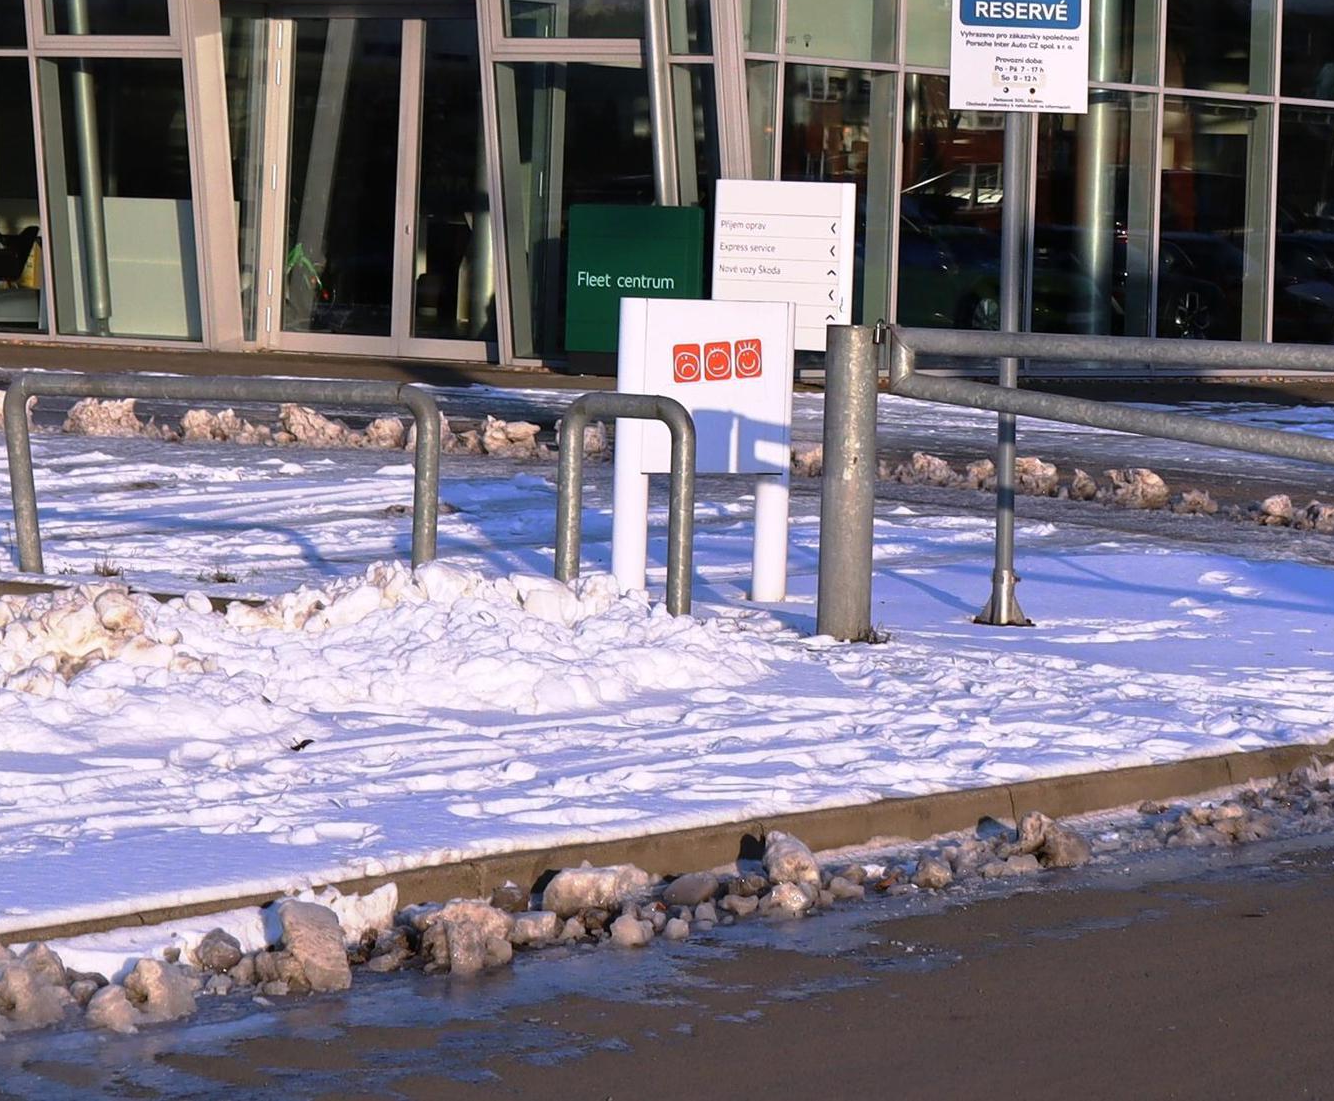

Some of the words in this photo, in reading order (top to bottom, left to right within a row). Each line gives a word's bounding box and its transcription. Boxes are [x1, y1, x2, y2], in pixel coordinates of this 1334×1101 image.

[975, 0, 1068, 21] RESERVÉ
[719, 242, 748, 252] Express
[719, 264, 738, 273] Nové
[739, 266, 757, 275] vozy
[758, 264, 781, 275] Škoda
[577, 271, 611, 287] Fleet
[617, 274, 675, 289] centrum
